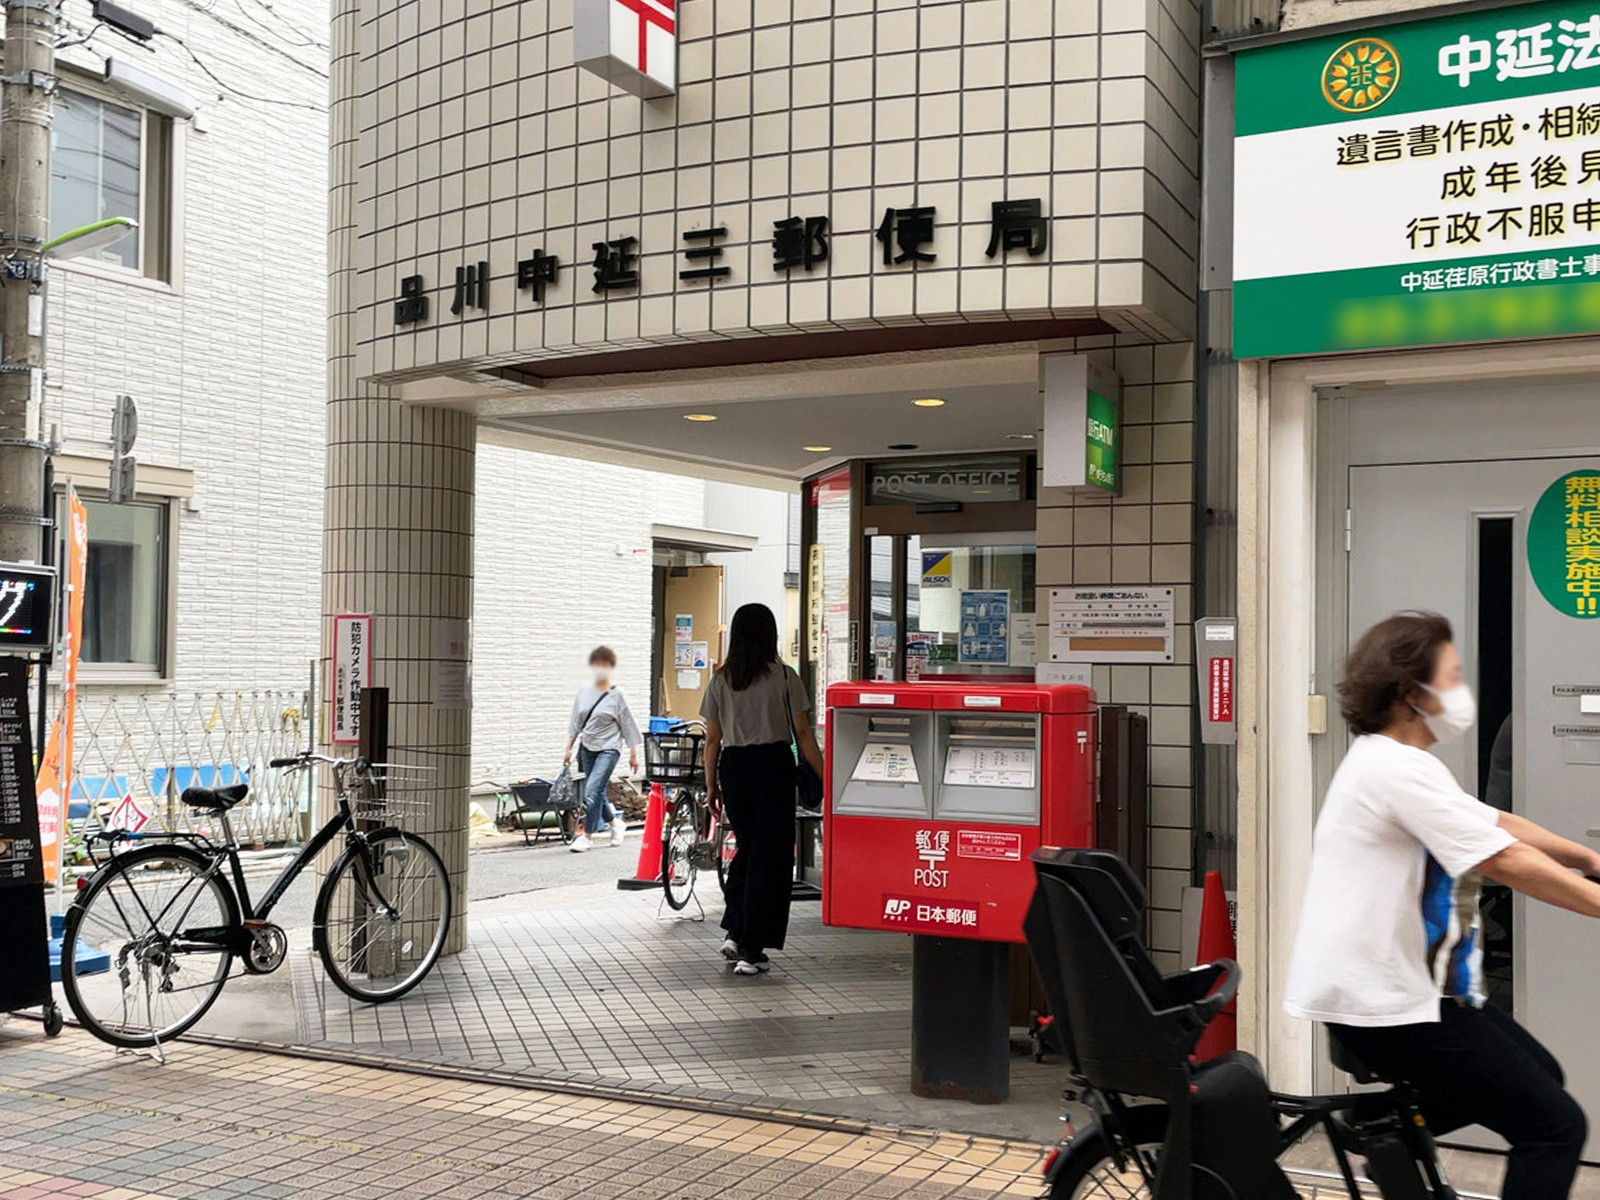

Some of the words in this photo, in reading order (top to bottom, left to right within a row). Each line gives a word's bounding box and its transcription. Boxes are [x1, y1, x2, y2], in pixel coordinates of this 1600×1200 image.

[395, 198, 1048, 326] 品川中延三郵便局
[872, 474, 930, 494] POST
[937, 470, 1019, 491] OFFICE
[915, 829, 950, 852] 郵便
[914, 869, 949, 888] POST
[916, 905, 977, 926] 日本郵便
